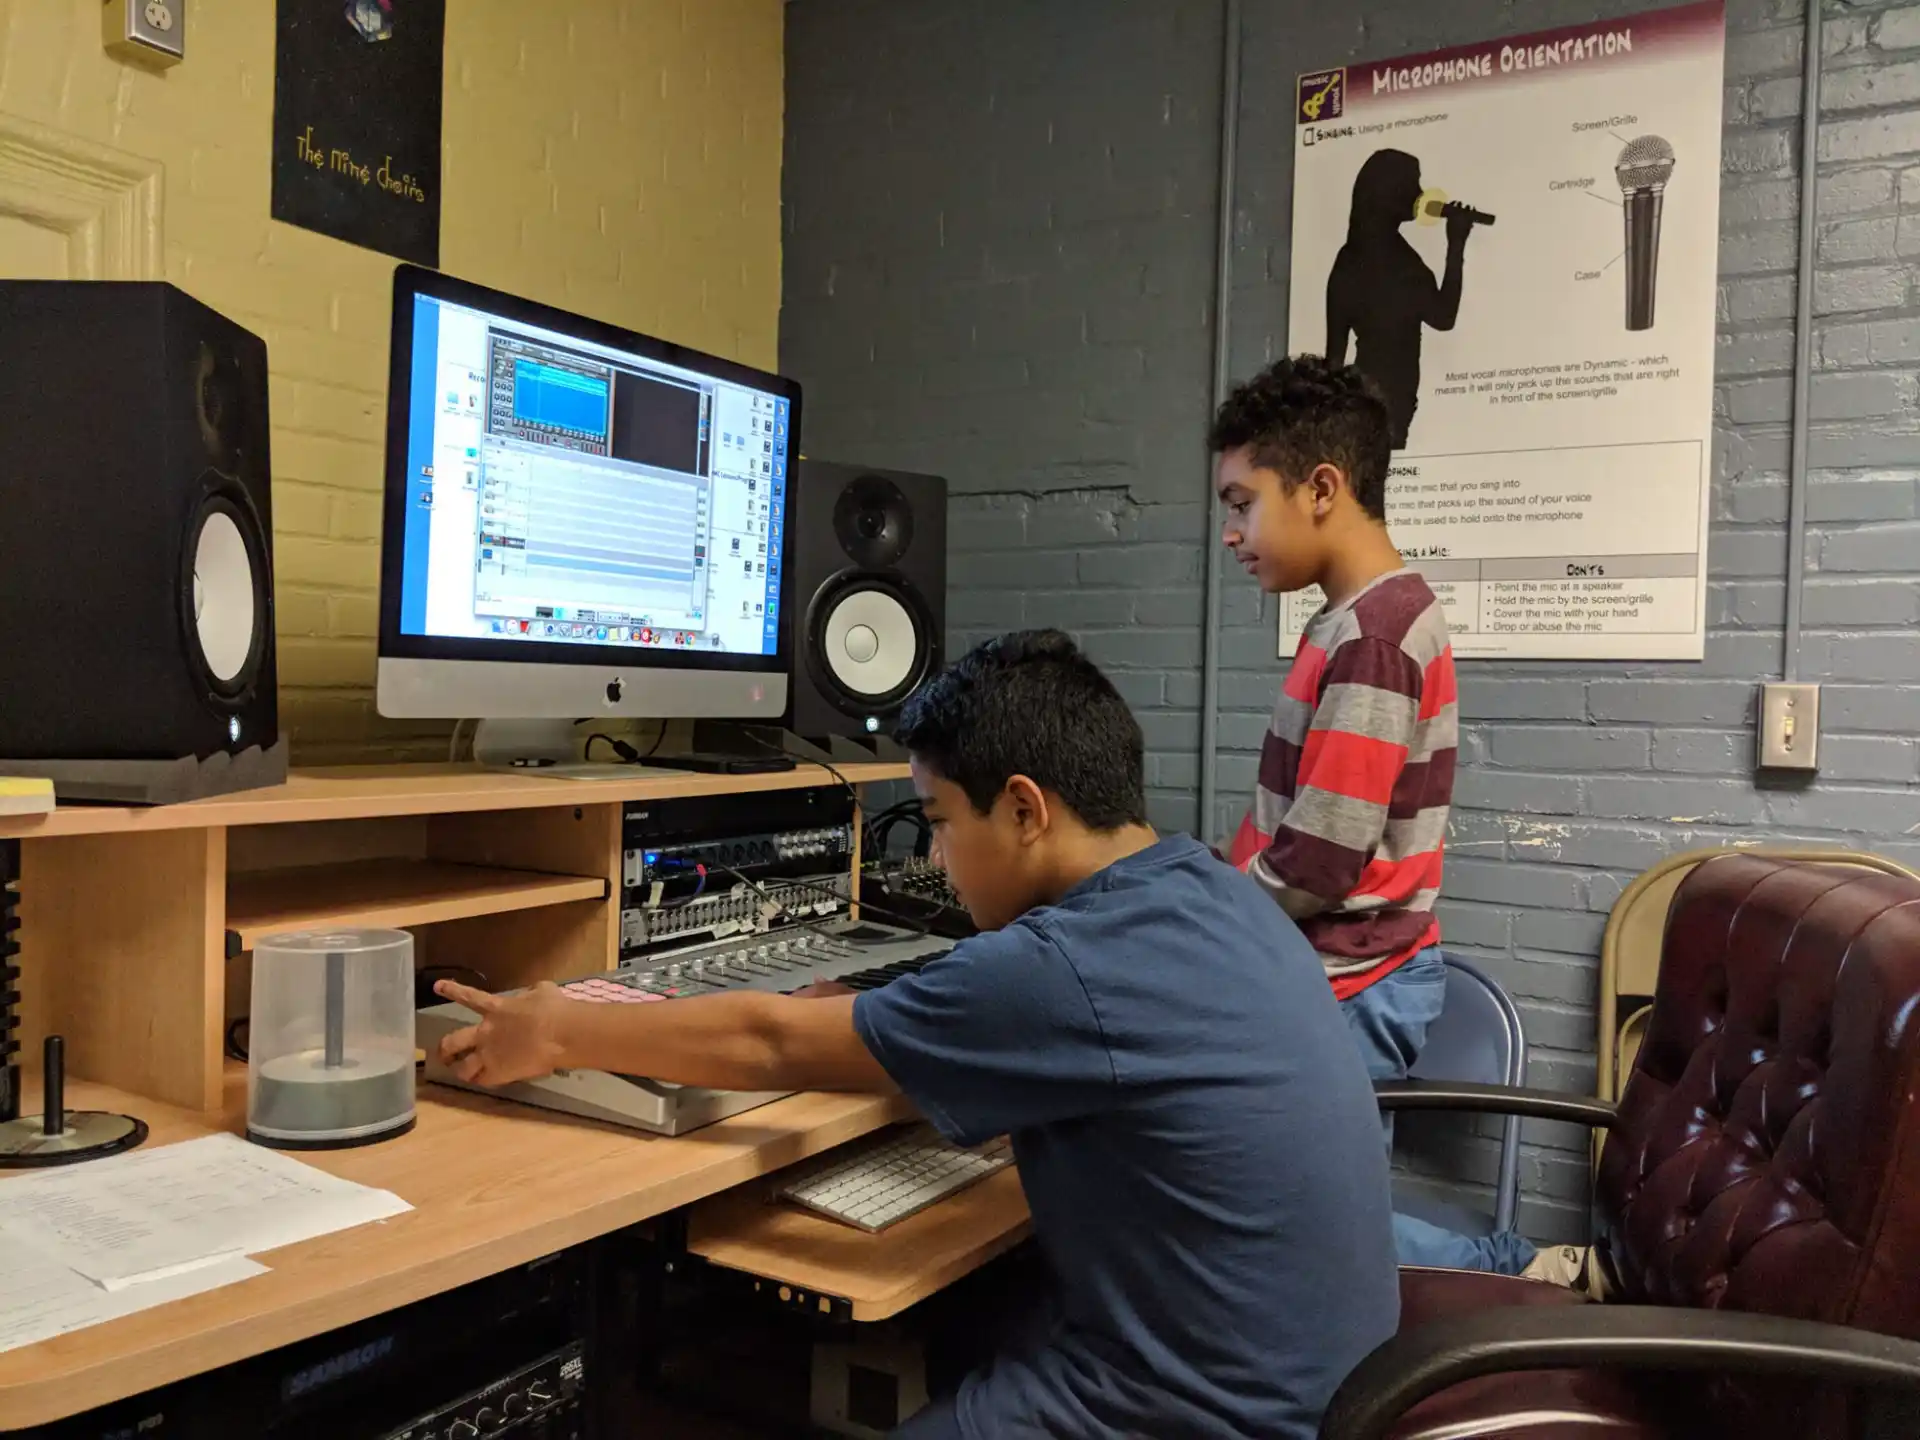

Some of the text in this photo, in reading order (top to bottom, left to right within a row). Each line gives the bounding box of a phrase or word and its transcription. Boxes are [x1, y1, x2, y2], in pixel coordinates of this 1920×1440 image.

[1358, 123, 1384, 134] Using
[1386, 122, 1394, 130] a
[1395, 113, 1448, 128] microphone
[1572, 114, 1638, 132] Screen/Grille
[1549, 176, 1596, 191] Cartridge
[1574, 269, 1602, 281] Case
[1445, 371, 1468, 382] Most
[1471, 369, 1496, 380] vocal
[1498, 364, 1562, 379] microphones
[1564, 363, 1581, 372] are
[1583, 358, 1628, 372] Dynamic
[1638, 354, 1669, 366] which
[1434, 367, 1680, 396] means it will only pick up the sounds that are right
[1501, 393, 1523, 404] front
[1525, 391, 1537, 402] of
[1537, 391, 1554, 401] the
[1556, 386, 1618, 400] screen/grille
[1386, 465, 1420, 477] OPHONE:
[1393, 483, 1402, 493] of
[1404, 483, 1419, 493] the
[1421, 484, 1438, 492] mic
[1440, 482, 1457, 492] that
[1460, 483, 1478, 492] you
[1480, 481, 1500, 491] sing
[1502, 479, 1521, 489] into
[1398, 501, 1415, 510] mic
[1418, 500, 1435, 509] that
[1437, 499, 1462, 509] picks
[1463, 499, 1476, 509] up
[1478, 498, 1494, 507] the
[1496, 496, 1526, 506] sound
[1528, 494, 1541, 504] of
[1541, 495, 1562, 505] your
[1565, 493, 1592, 503] voice
[1394, 516, 1411, 526] that
[1413, 516, 1421, 525] is
[1424, 515, 1446, 525] used
[1448, 515, 1458, 524] to
[1460, 514, 1480, 524] hold
[1483, 513, 1505, 523] onto
[1507, 512, 1522, 522] the
[1525, 511, 1583, 523] microphone
[1494, 582, 1519, 592] Point
[1522, 582, 1537, 592] the
[1540, 582, 1558, 592] mic
[1560, 583, 1570, 591] at
[1582, 581, 1624, 593] speaker
[1494, 594, 1654, 606] Hold the mic by the screen/grille
[1493, 607, 1638, 620] Cover the mic with your hand
[1493, 621, 1603, 632] Drop or abuse the mic
